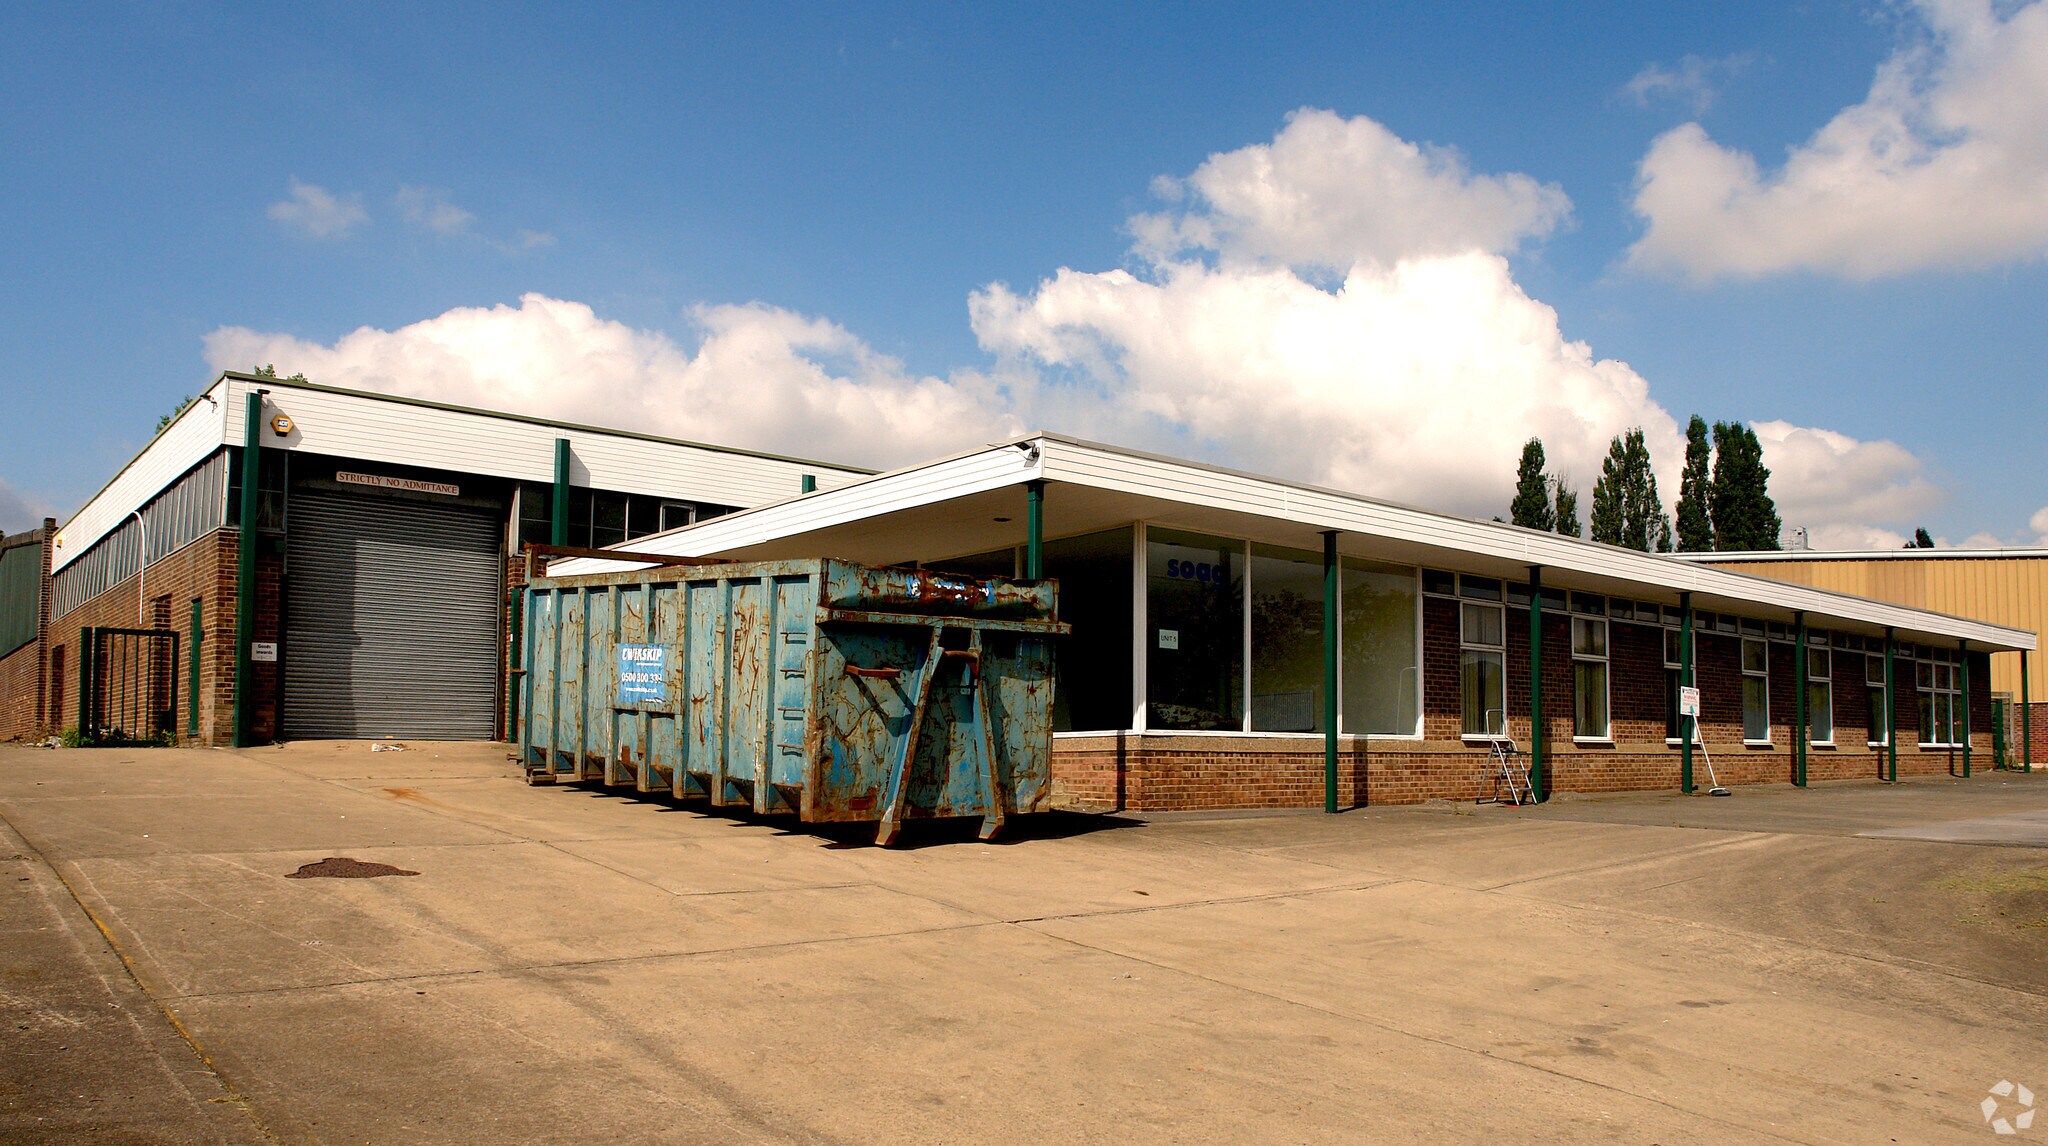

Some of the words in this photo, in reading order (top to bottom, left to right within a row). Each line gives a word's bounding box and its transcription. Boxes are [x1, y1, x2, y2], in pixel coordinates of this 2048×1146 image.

[339, 472, 382, 484] STRICTLY
[386, 477, 400, 487] NO
[402, 479, 458, 494] ADMITTANCE
[621, 671, 637, 682] 0500
[637, 672, 649, 683] 300
